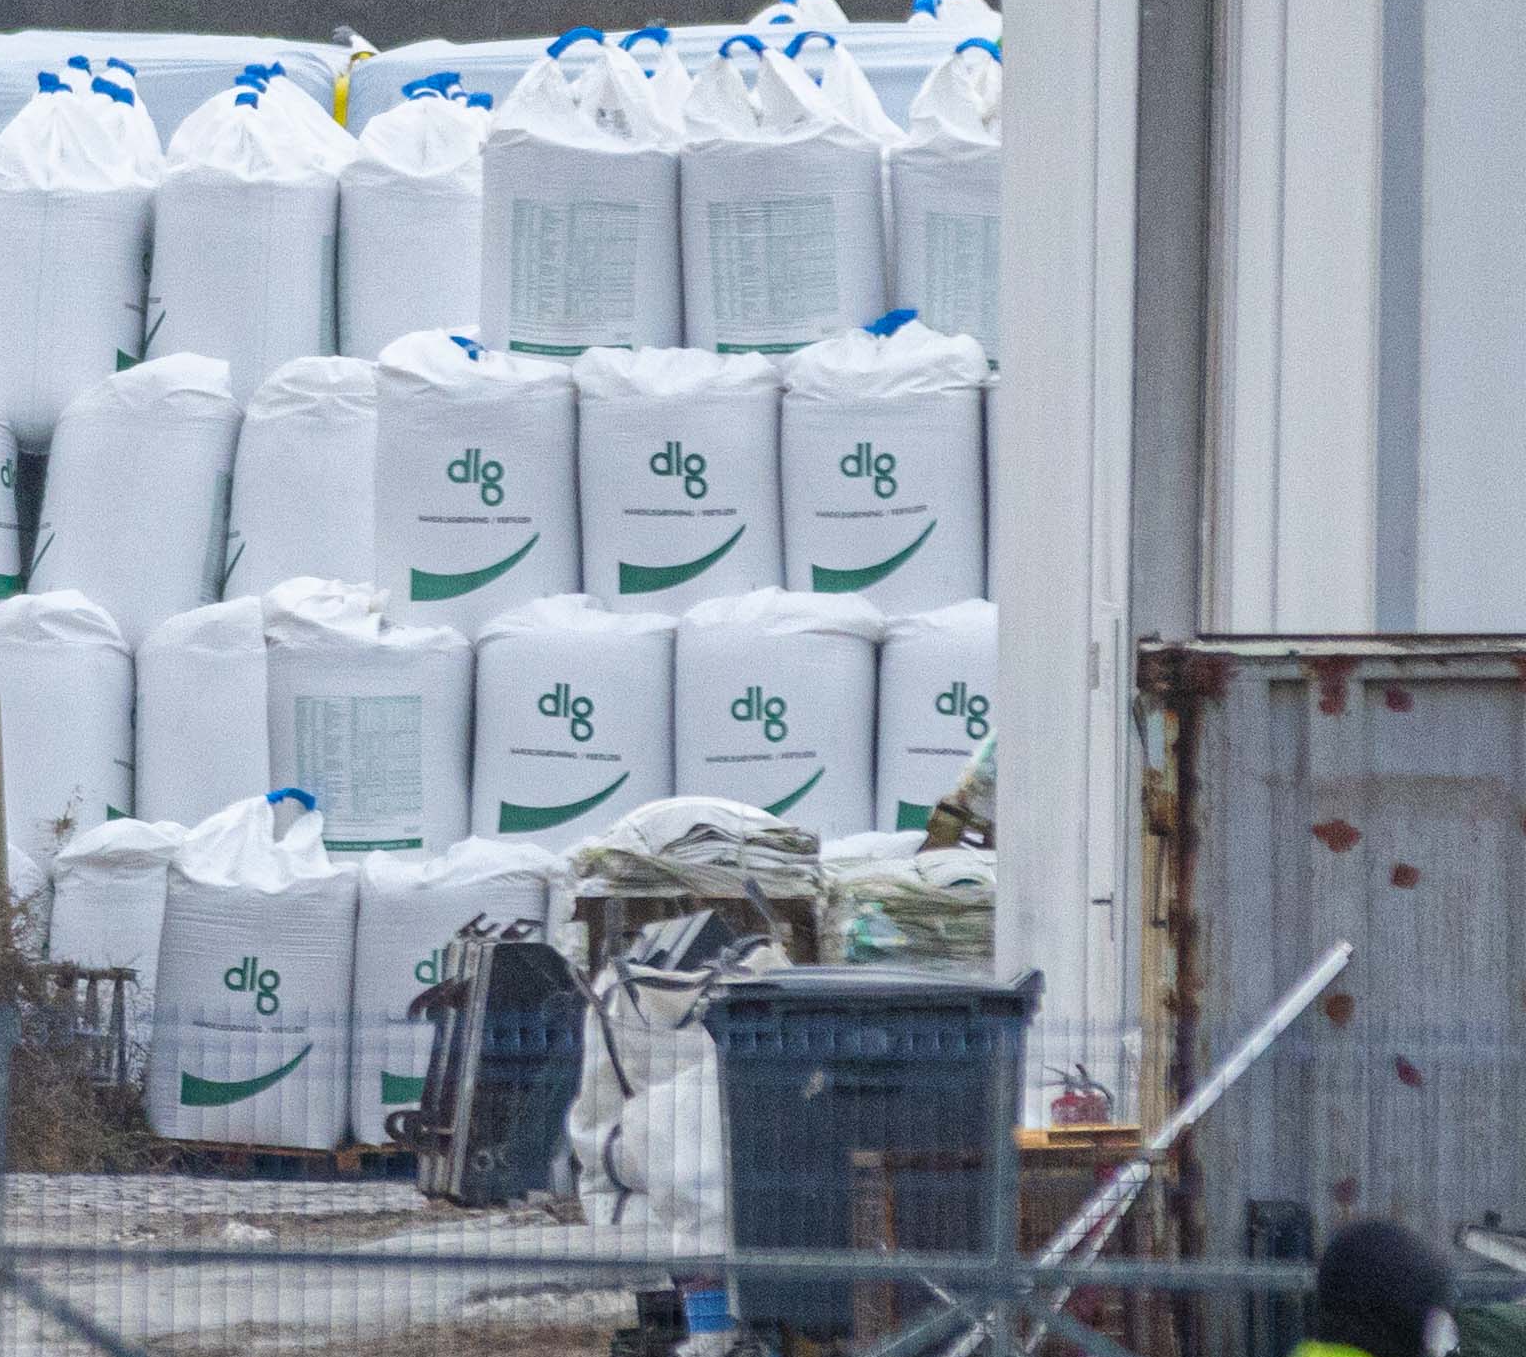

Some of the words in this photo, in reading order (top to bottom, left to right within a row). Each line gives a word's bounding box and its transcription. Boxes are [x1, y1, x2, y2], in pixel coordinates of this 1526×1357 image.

[447, 449, 505, 507] dlg
[649, 441, 707, 500] dlg
[839, 441, 897, 500] dlg
[537, 682, 595, 743] dlg
[730, 686, 788, 744] dlg
[935, 680, 991, 741] dlg
[224, 955, 281, 1016] dlg
